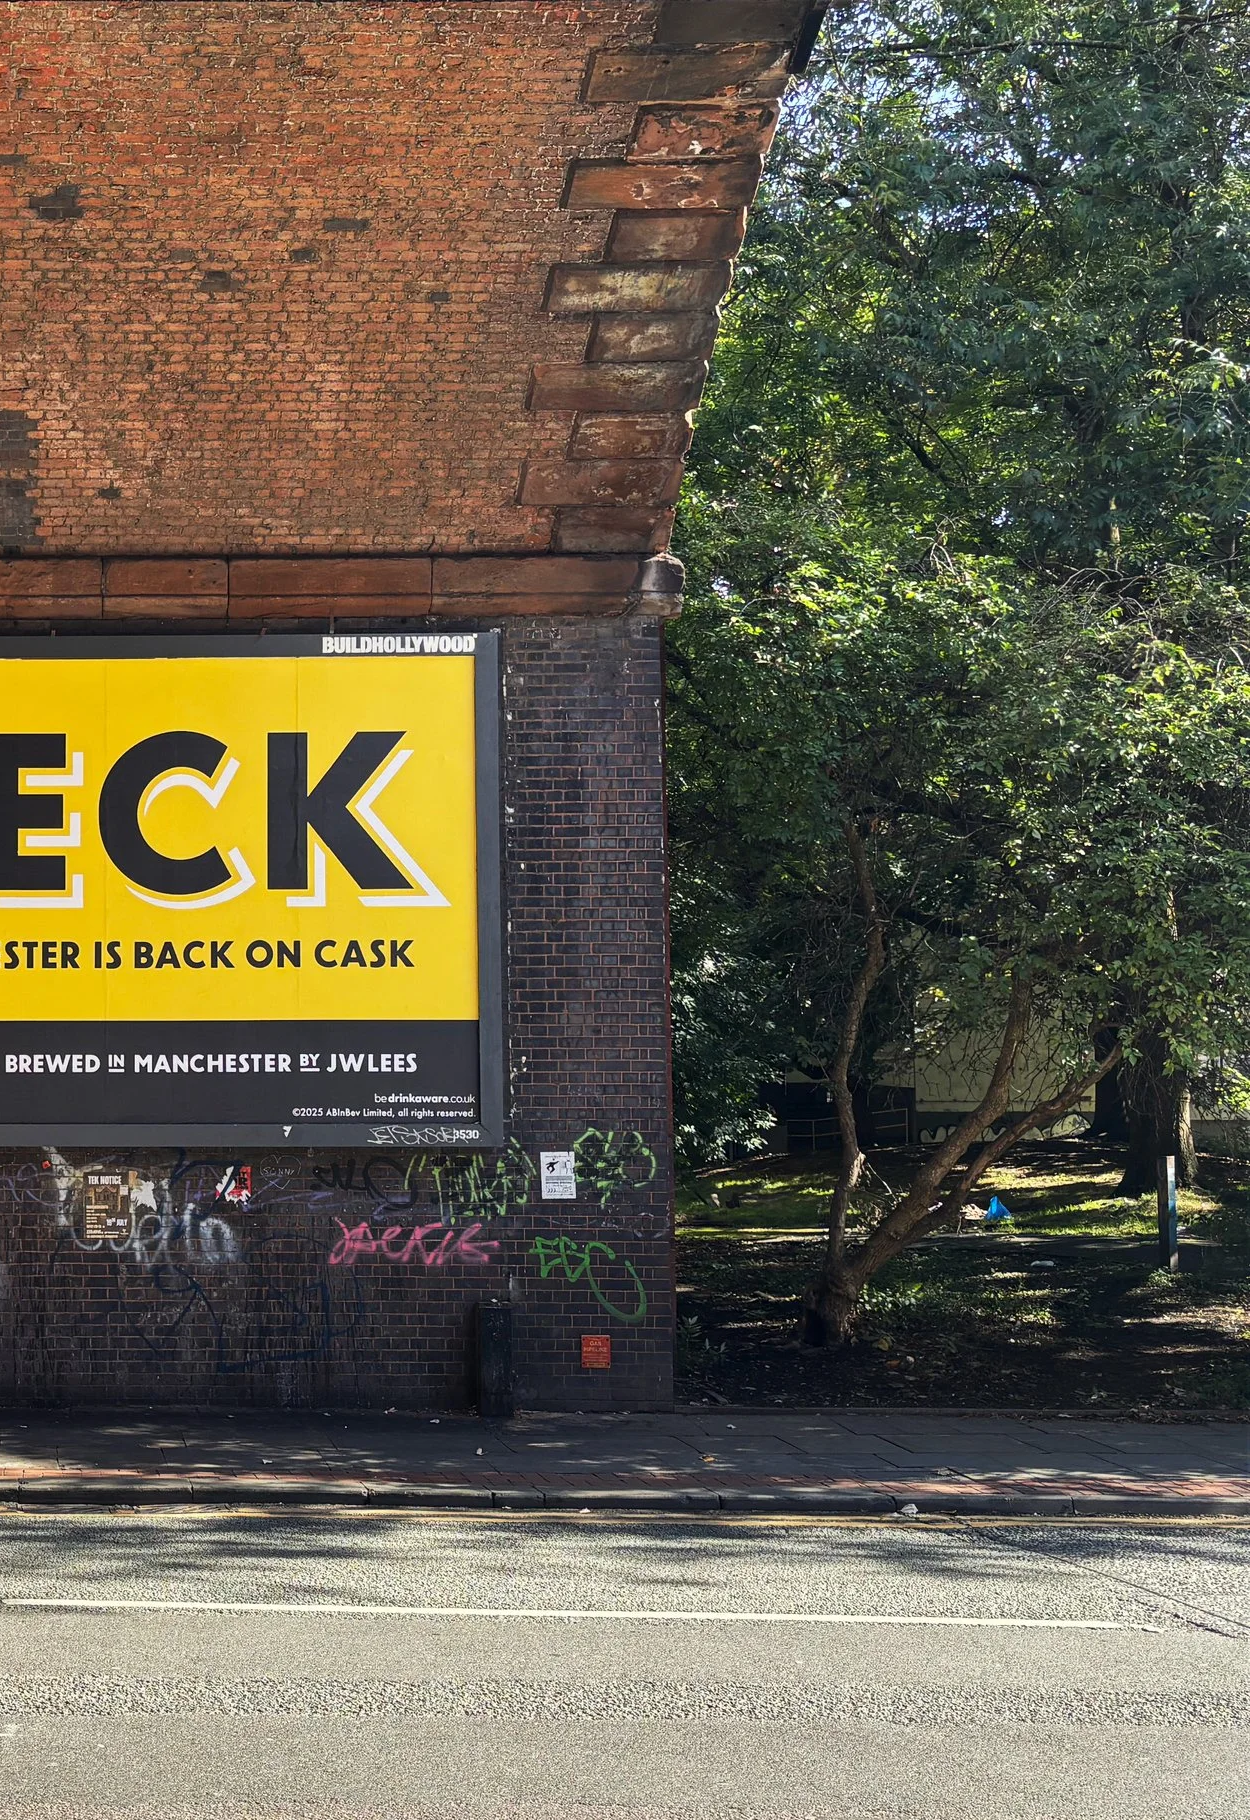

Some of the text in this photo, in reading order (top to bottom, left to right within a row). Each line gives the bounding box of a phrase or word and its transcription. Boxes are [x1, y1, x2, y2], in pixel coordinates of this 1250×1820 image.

[322, 635, 476, 654] BUILDHOLLYWOOD
[94, 940, 122, 970] IS
[134, 940, 235, 970] BACK
[245, 939, 301, 969] ON
[314, 939, 415, 969] CASK
[5, 1054, 101, 1073] BREWED
[108, 1054, 125, 1066] IN
[134, 1053, 292, 1073] MANCHESTER
[299, 1053, 321, 1066] BY
[374, 1092, 476, 1104] bedrinkaware.co.uk
[326, 1107, 361, 1117] ABInBev
[363, 1107, 395, 1118] Limited,
[398, 1107, 409, 1117] all
[411, 1107, 435, 1120] rights
[437, 1108, 476, 1118] reserved.
[100, 1175, 123, 1185] NOTICE
